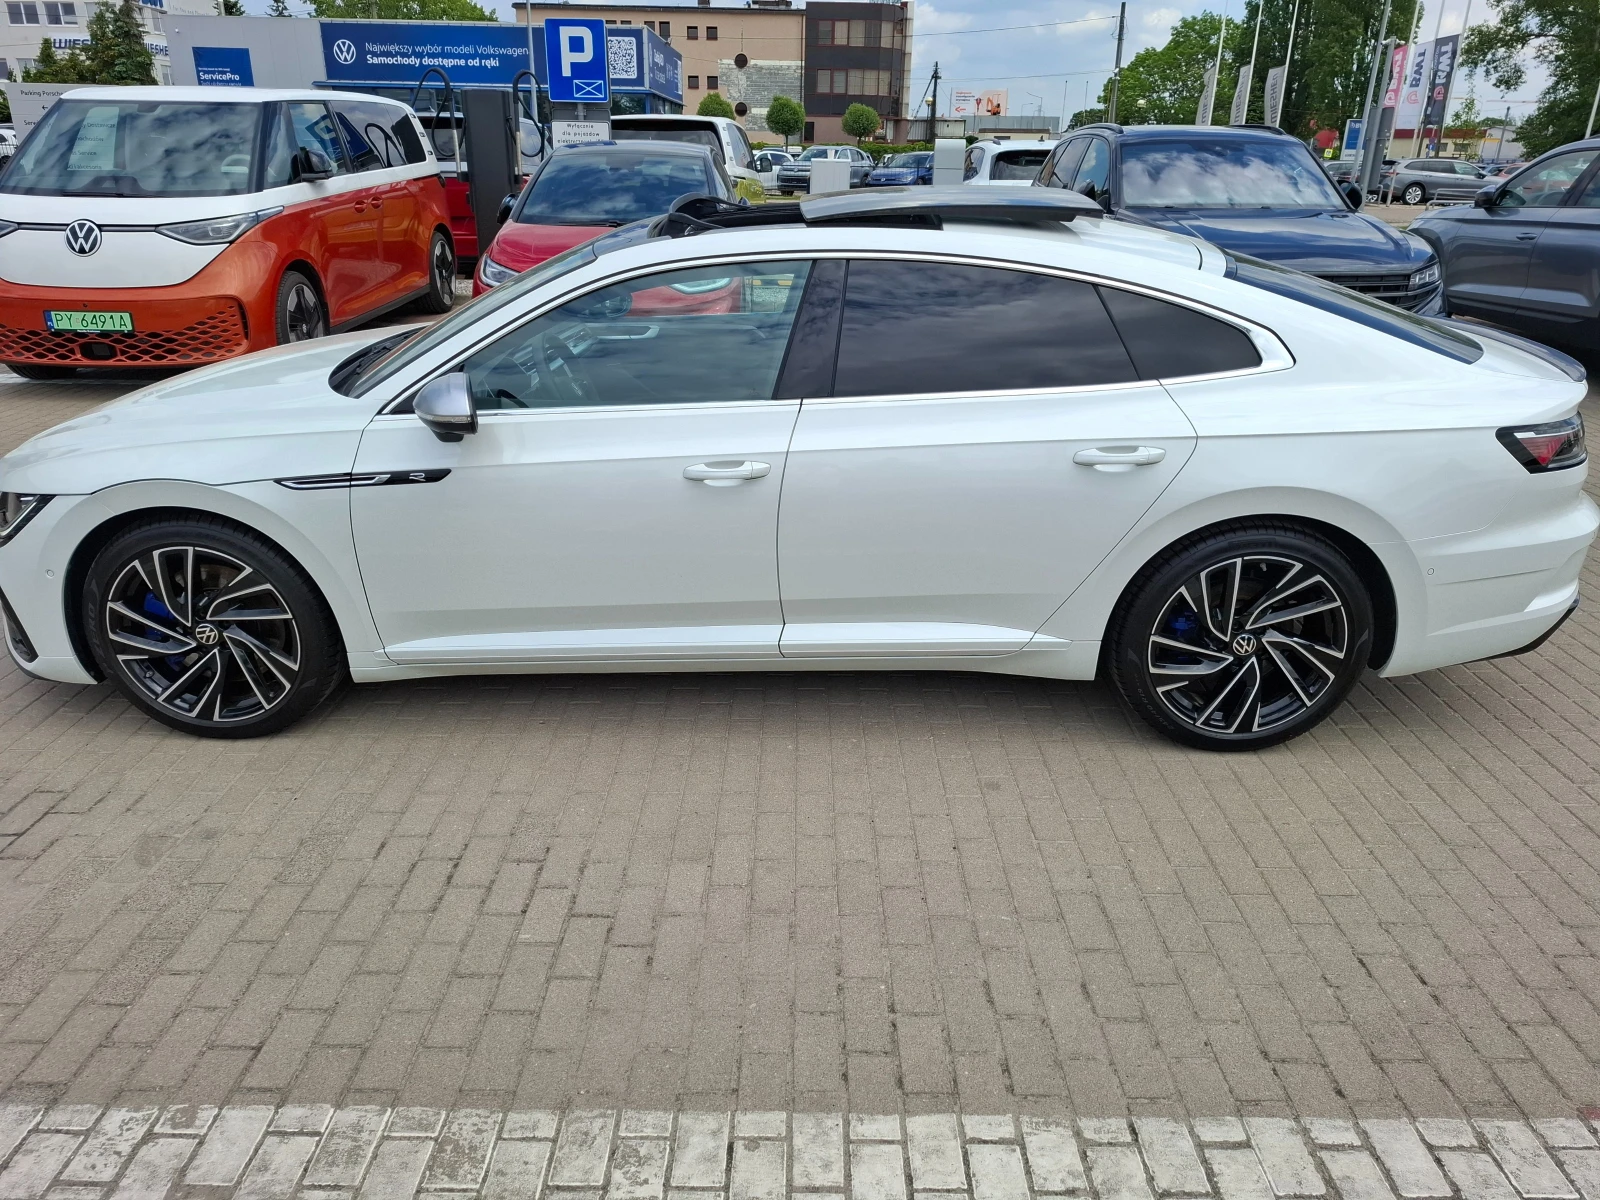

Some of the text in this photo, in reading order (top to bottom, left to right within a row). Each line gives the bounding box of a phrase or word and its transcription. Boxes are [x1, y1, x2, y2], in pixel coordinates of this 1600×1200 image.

[365, 42, 529, 57] Największy wybór modeli Volkswagen
[559, 26, 593, 77] P
[366, 54, 500, 69] Samochody dostępne od ręki
[199, 71, 240, 81] ServicePro
[54, 313, 128, 329] PY 6491A
[409, 472, 426, 482] R
